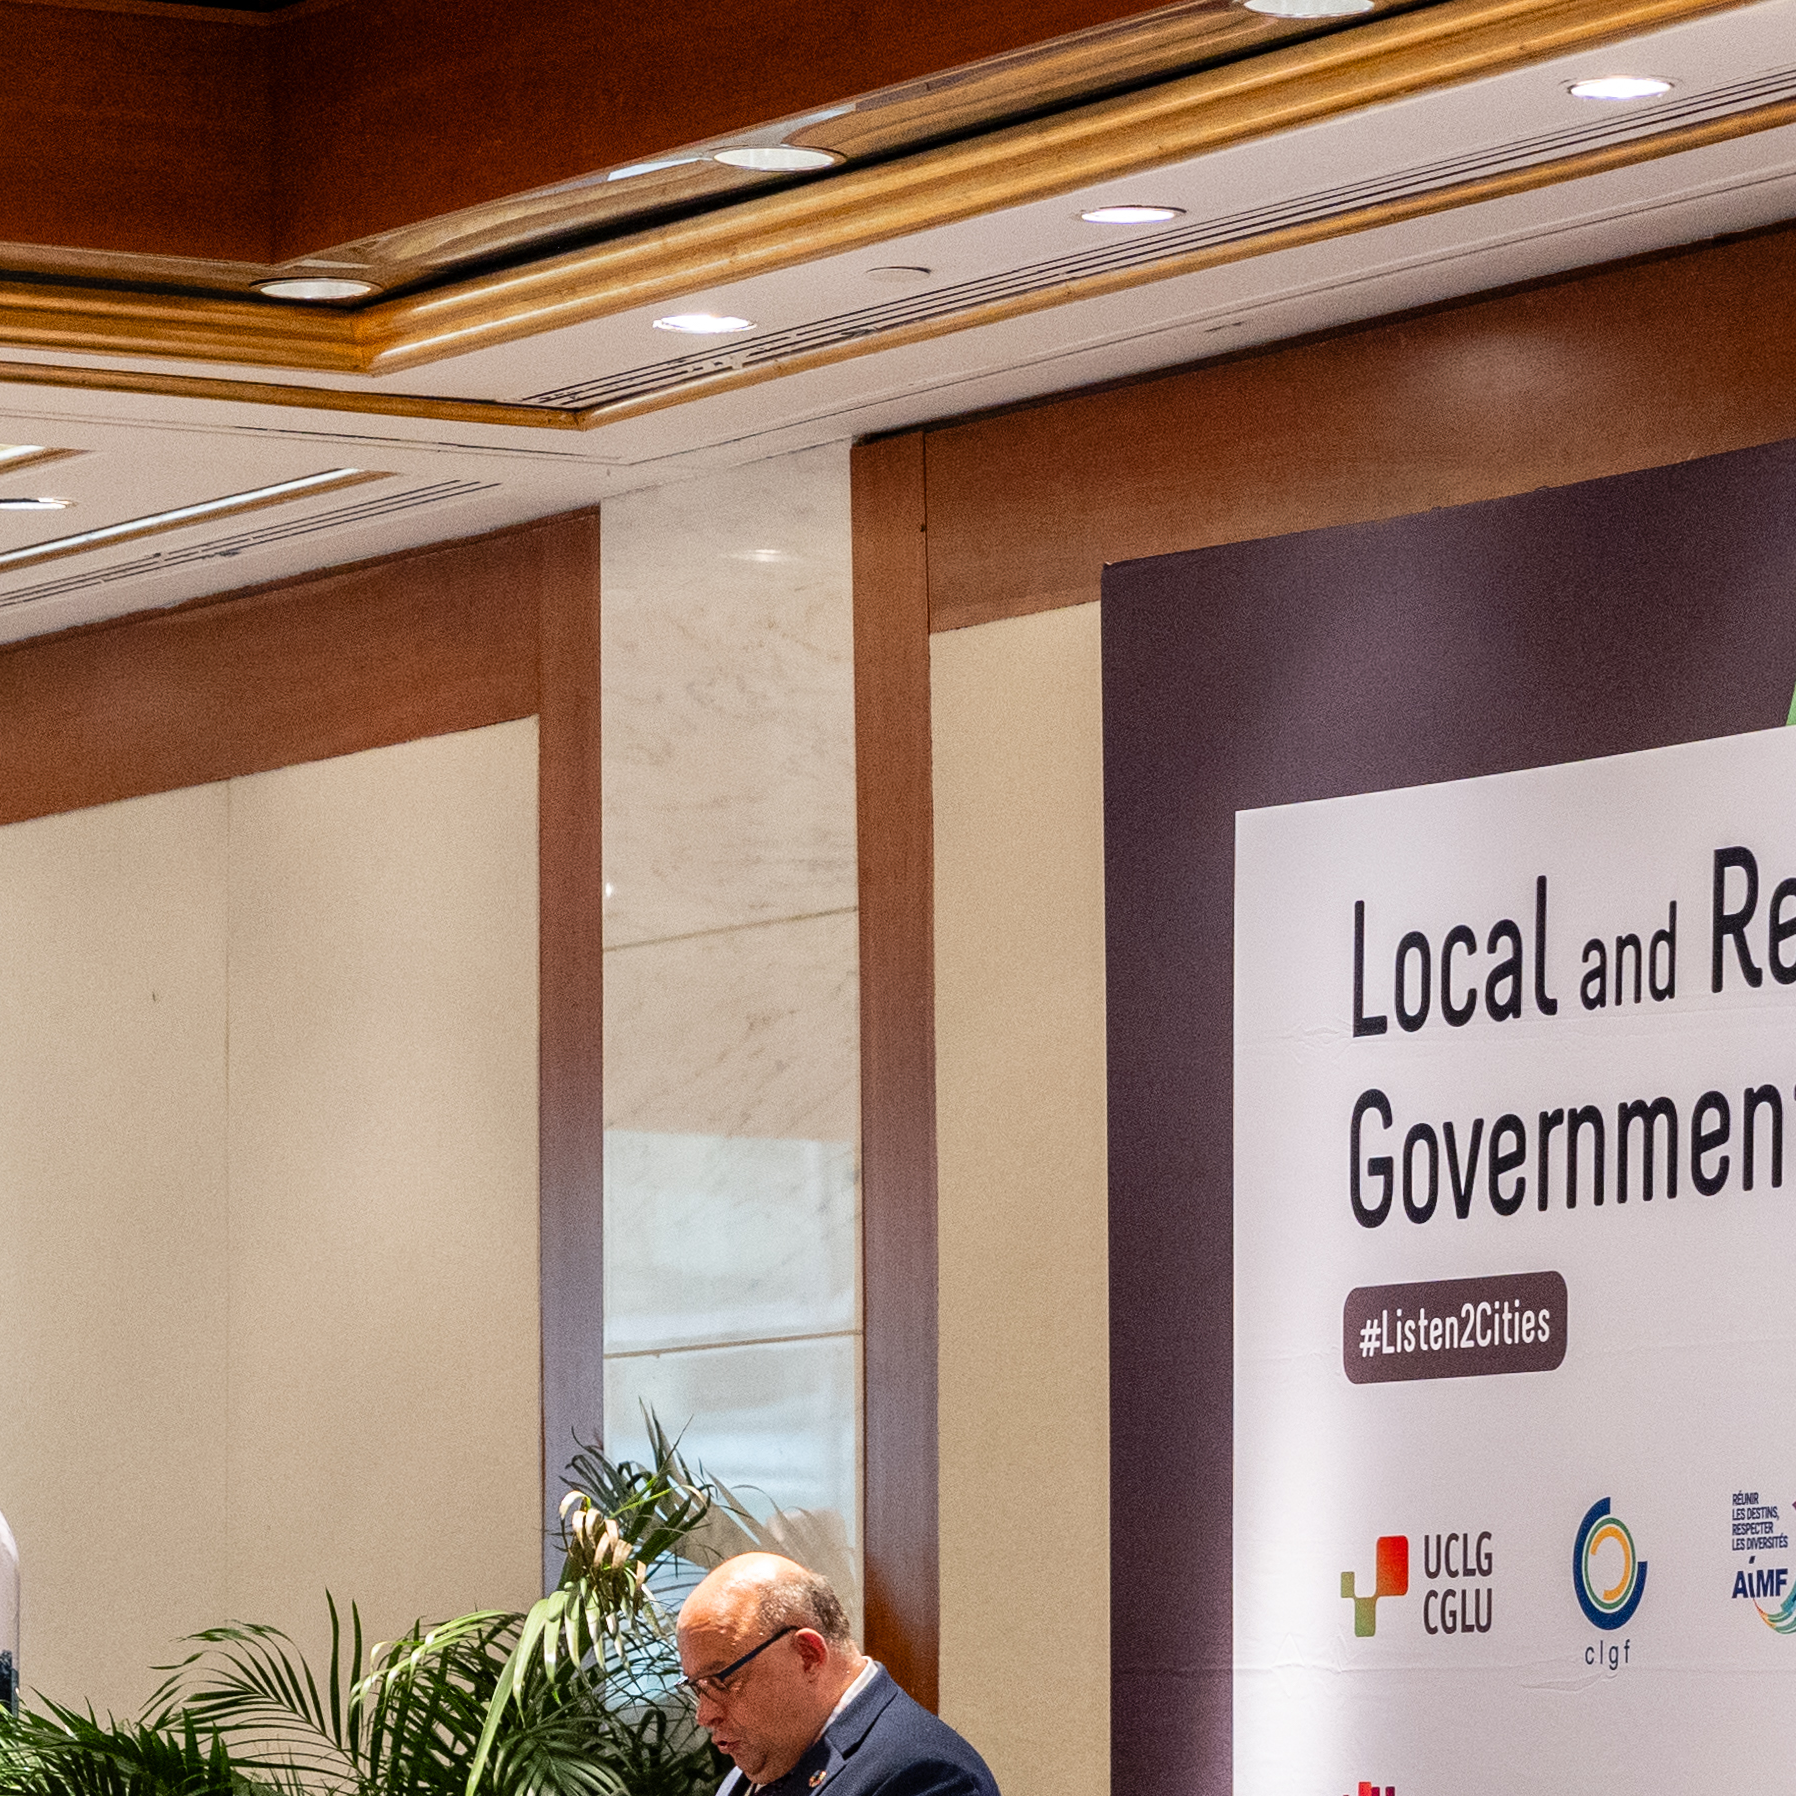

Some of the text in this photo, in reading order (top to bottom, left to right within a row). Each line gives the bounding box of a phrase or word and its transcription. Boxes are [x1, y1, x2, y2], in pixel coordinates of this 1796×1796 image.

[1353, 875, 1557, 1038] Local
[1580, 900, 1677, 1009] and
[1359, 1301, 1551, 1358] #Listen2Cities
[1732, 1506, 1779, 1521] LES DESTINS,
[1732, 1522, 1773, 1535] RESPECTER
[1424, 1531, 1493, 1579] UCLG
[1732, 1533, 1788, 1551] LES DIVERSITÉS
[1423, 1587, 1492, 1635] CGLU
[1584, 1639, 1630, 1670] clgf
